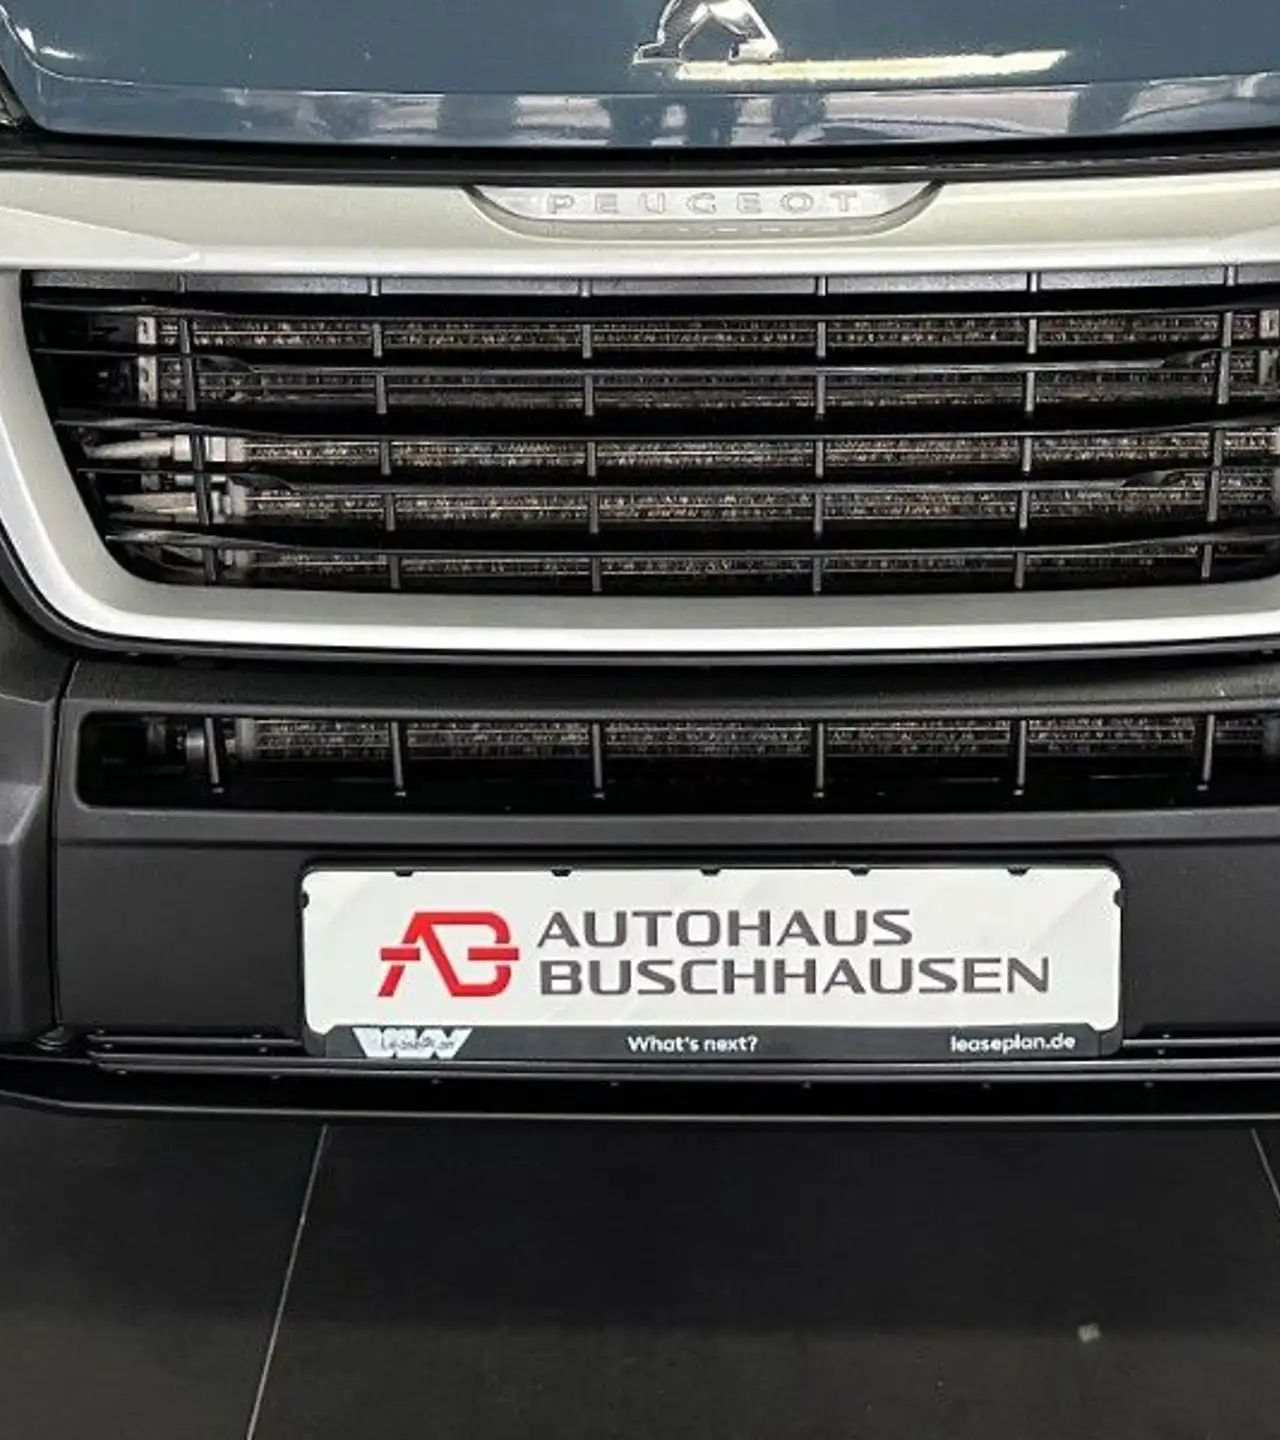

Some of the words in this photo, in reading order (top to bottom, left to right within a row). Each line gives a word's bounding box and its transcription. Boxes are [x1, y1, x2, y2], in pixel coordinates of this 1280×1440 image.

[545, 190, 859, 215] PEUGEOT
[536, 909, 913, 948] AUTOHAUS
[539, 956, 1050, 996] BUSCHHAUSEN
[626, 1034, 699, 1053] What's
[704, 1034, 759, 1053] next?
[950, 1033, 1076, 1055] leaseplan.de
